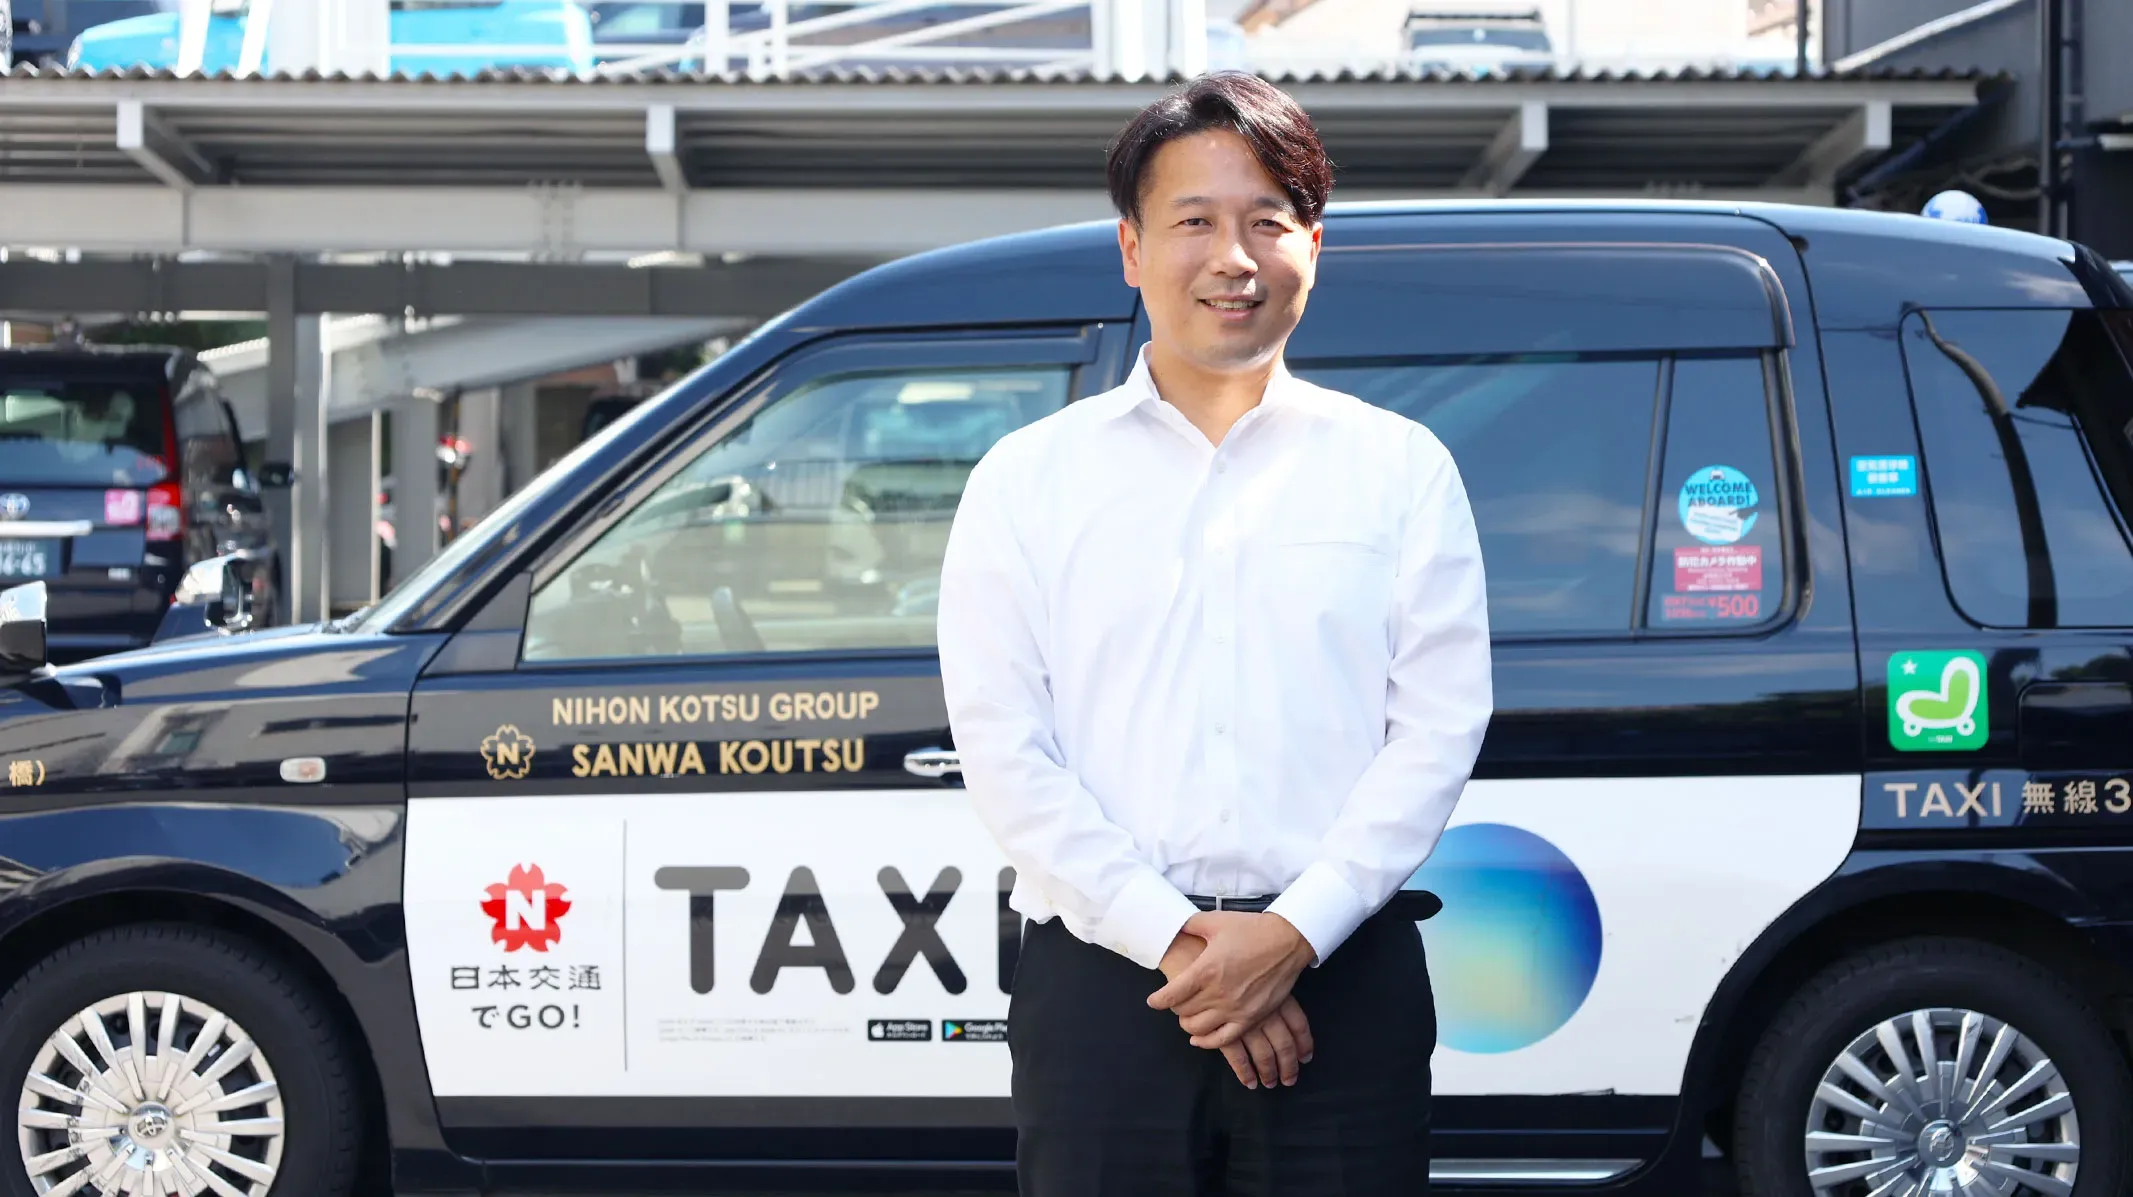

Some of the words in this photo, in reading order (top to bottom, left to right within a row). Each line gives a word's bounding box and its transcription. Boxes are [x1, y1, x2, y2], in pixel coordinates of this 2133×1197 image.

[1685, 481, 1753, 495] WELCOME
[1688, 495, 1750, 507] ABOARD!
[552, 696, 651, 726] NIHON
[659, 693, 760, 725] KOTSU
[768, 691, 880, 722] GROUP
[497, 741, 519, 766] N
[572, 740, 706, 777] SANWA
[719, 738, 865, 774] KOUTSU
[1883, 782, 2002, 818] TAXI
[505, 889, 547, 931] N
[654, 864, 1022, 996] TAXI
[451, 964, 601, 990] 日本交通
[471, 1004, 580, 1030] でGO!
[886, 1022, 904, 1032] App
[904, 1021, 928, 1032] Store
[964, 1021, 993, 1033] Google
[994, 1021, 1008, 1032] Pla
